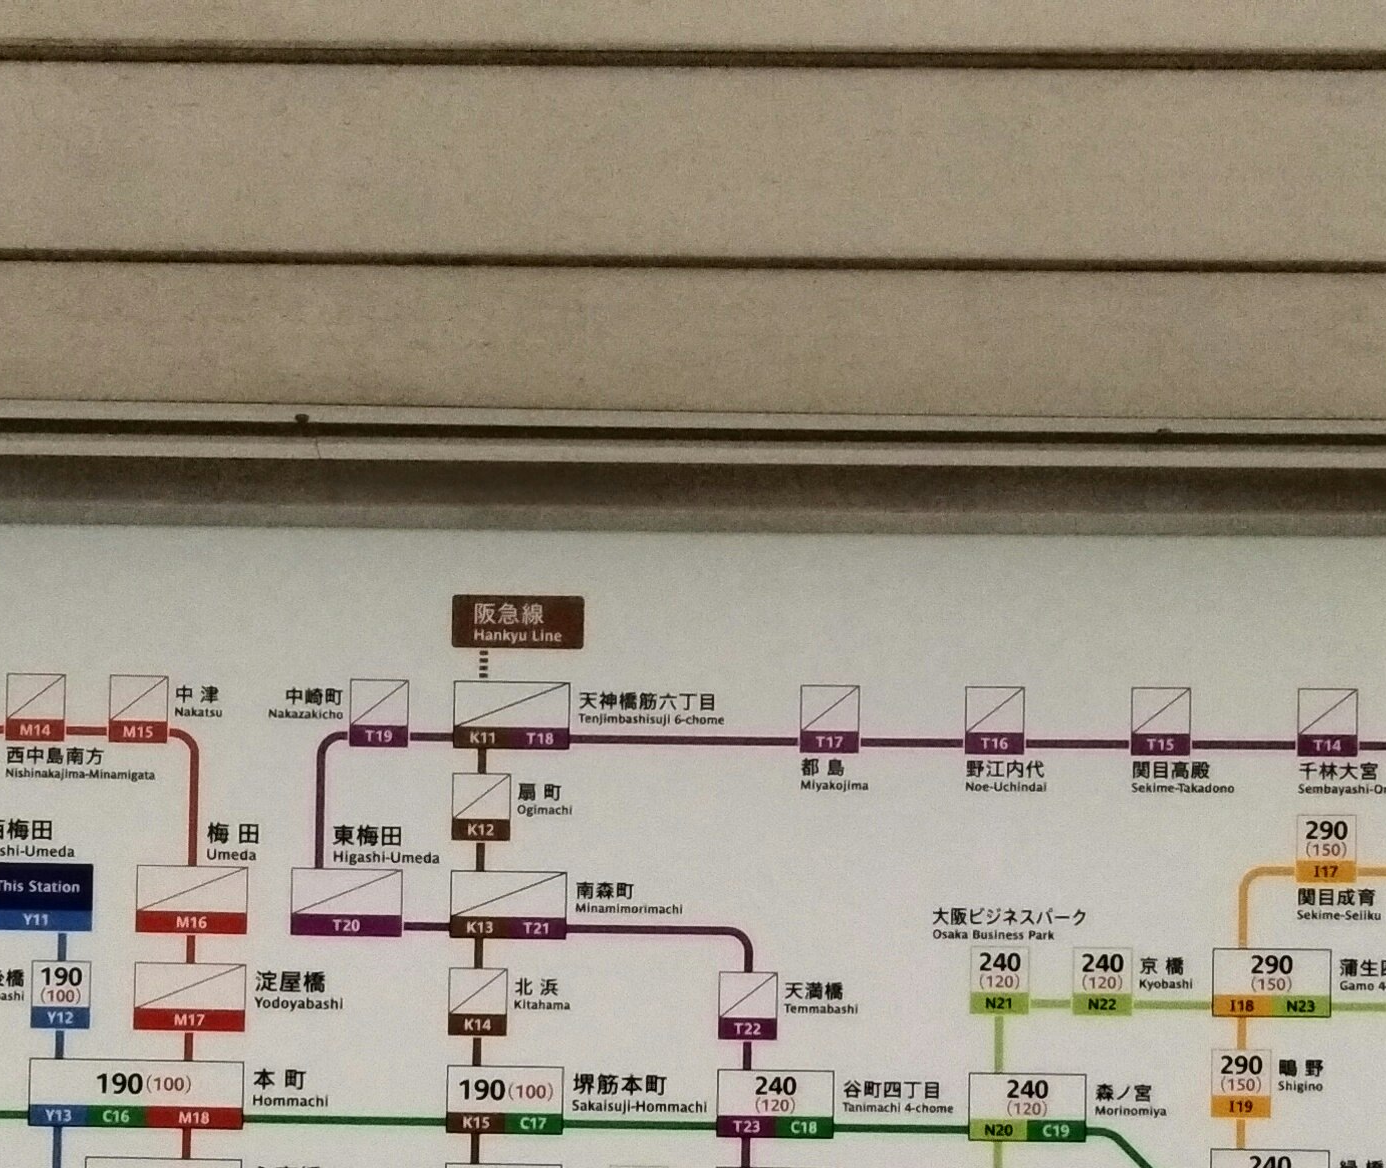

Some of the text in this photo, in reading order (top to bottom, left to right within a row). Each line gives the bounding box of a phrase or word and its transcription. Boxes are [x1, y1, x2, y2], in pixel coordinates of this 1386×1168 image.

[471, 602, 543, 628] 阪急線
[474, 629, 562, 644] Hankyu Line
[286, 688, 342, 705] 中崎町
[580, 692, 714, 711] 天神橋筋六丁目
[175, 707, 222, 717] Nakatsu
[269, 709, 343, 719] Nakazakicho
[579, 713, 724, 726] Tenjimbashisuji 6-chome
[20, 724, 50, 736] M14
[123, 726, 153, 738] M15
[365, 730, 392, 742] T19
[470, 732, 494, 743] K11
[527, 733, 553, 744] T18
[816, 736, 843, 748] T17
[7, 747, 103, 765] 西中島南方
[6, 768, 155, 782] Nishinakajima-Minamigata
[967, 760, 1044, 778] 野江内代
[1133, 761, 1209, 779] 関目高殿
[1300, 762, 1378, 780] 千林大宮
[801, 780, 868, 792] Miyakojima
[966, 782, 1046, 792] Noe-Uchindai
[1132, 783, 1234, 793] Sekime-Takadono
[517, 805, 572, 817] Ogimachi
[333, 825, 401, 846] 東梅田
[468, 824, 493, 836] K12
[207, 849, 256, 860] Umeda
[334, 851, 439, 865] Higashi-Umeda
[29, 880, 80, 892] Station
[577, 882, 633, 899] 南森町
[576, 903, 682, 914] Minamimorimachi
[24, 914, 48, 925] Y11
[177, 916, 207, 928] M16
[933, 908, 1085, 925] 大阪ビジネスパーク
[333, 919, 360, 931] T20
[933, 929, 1054, 940] Osaka Business Park
[255, 972, 326, 993] 淀屋橋
[255, 997, 342, 1011] Yodoyabashi
[574, 1074, 666, 1095] 堺筋本町
[1096, 1084, 1151, 1102] 森ノ宮
[253, 1095, 328, 1107] Hommachi
[573, 1100, 706, 1114] Sakaisuji-Hommachi
[1095, 1106, 1166, 1118] Morinomiya
